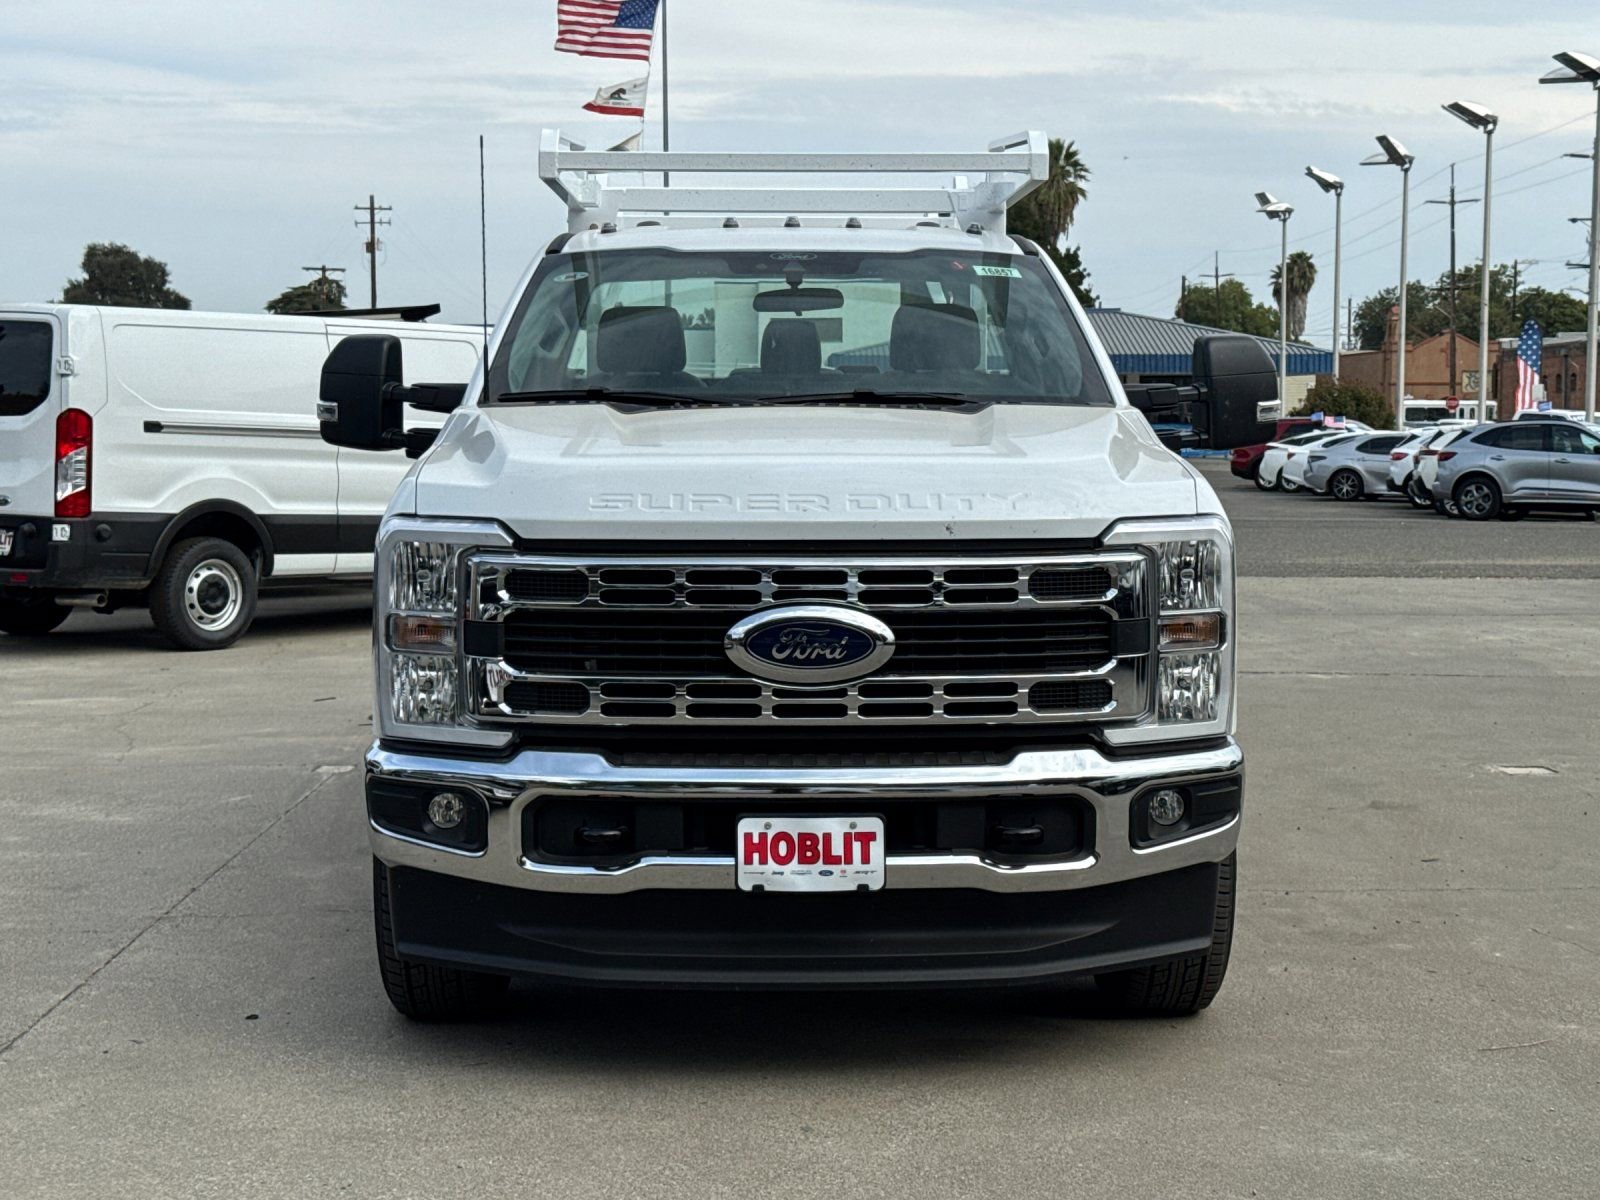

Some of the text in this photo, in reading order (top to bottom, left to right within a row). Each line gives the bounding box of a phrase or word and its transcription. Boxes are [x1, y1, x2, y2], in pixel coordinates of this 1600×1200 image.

[981, 267, 1013, 276] 16857
[588, 493, 1028, 513] SUPER DUTY
[772, 628, 849, 659] Ford
[743, 831, 877, 866] HOBLIT
